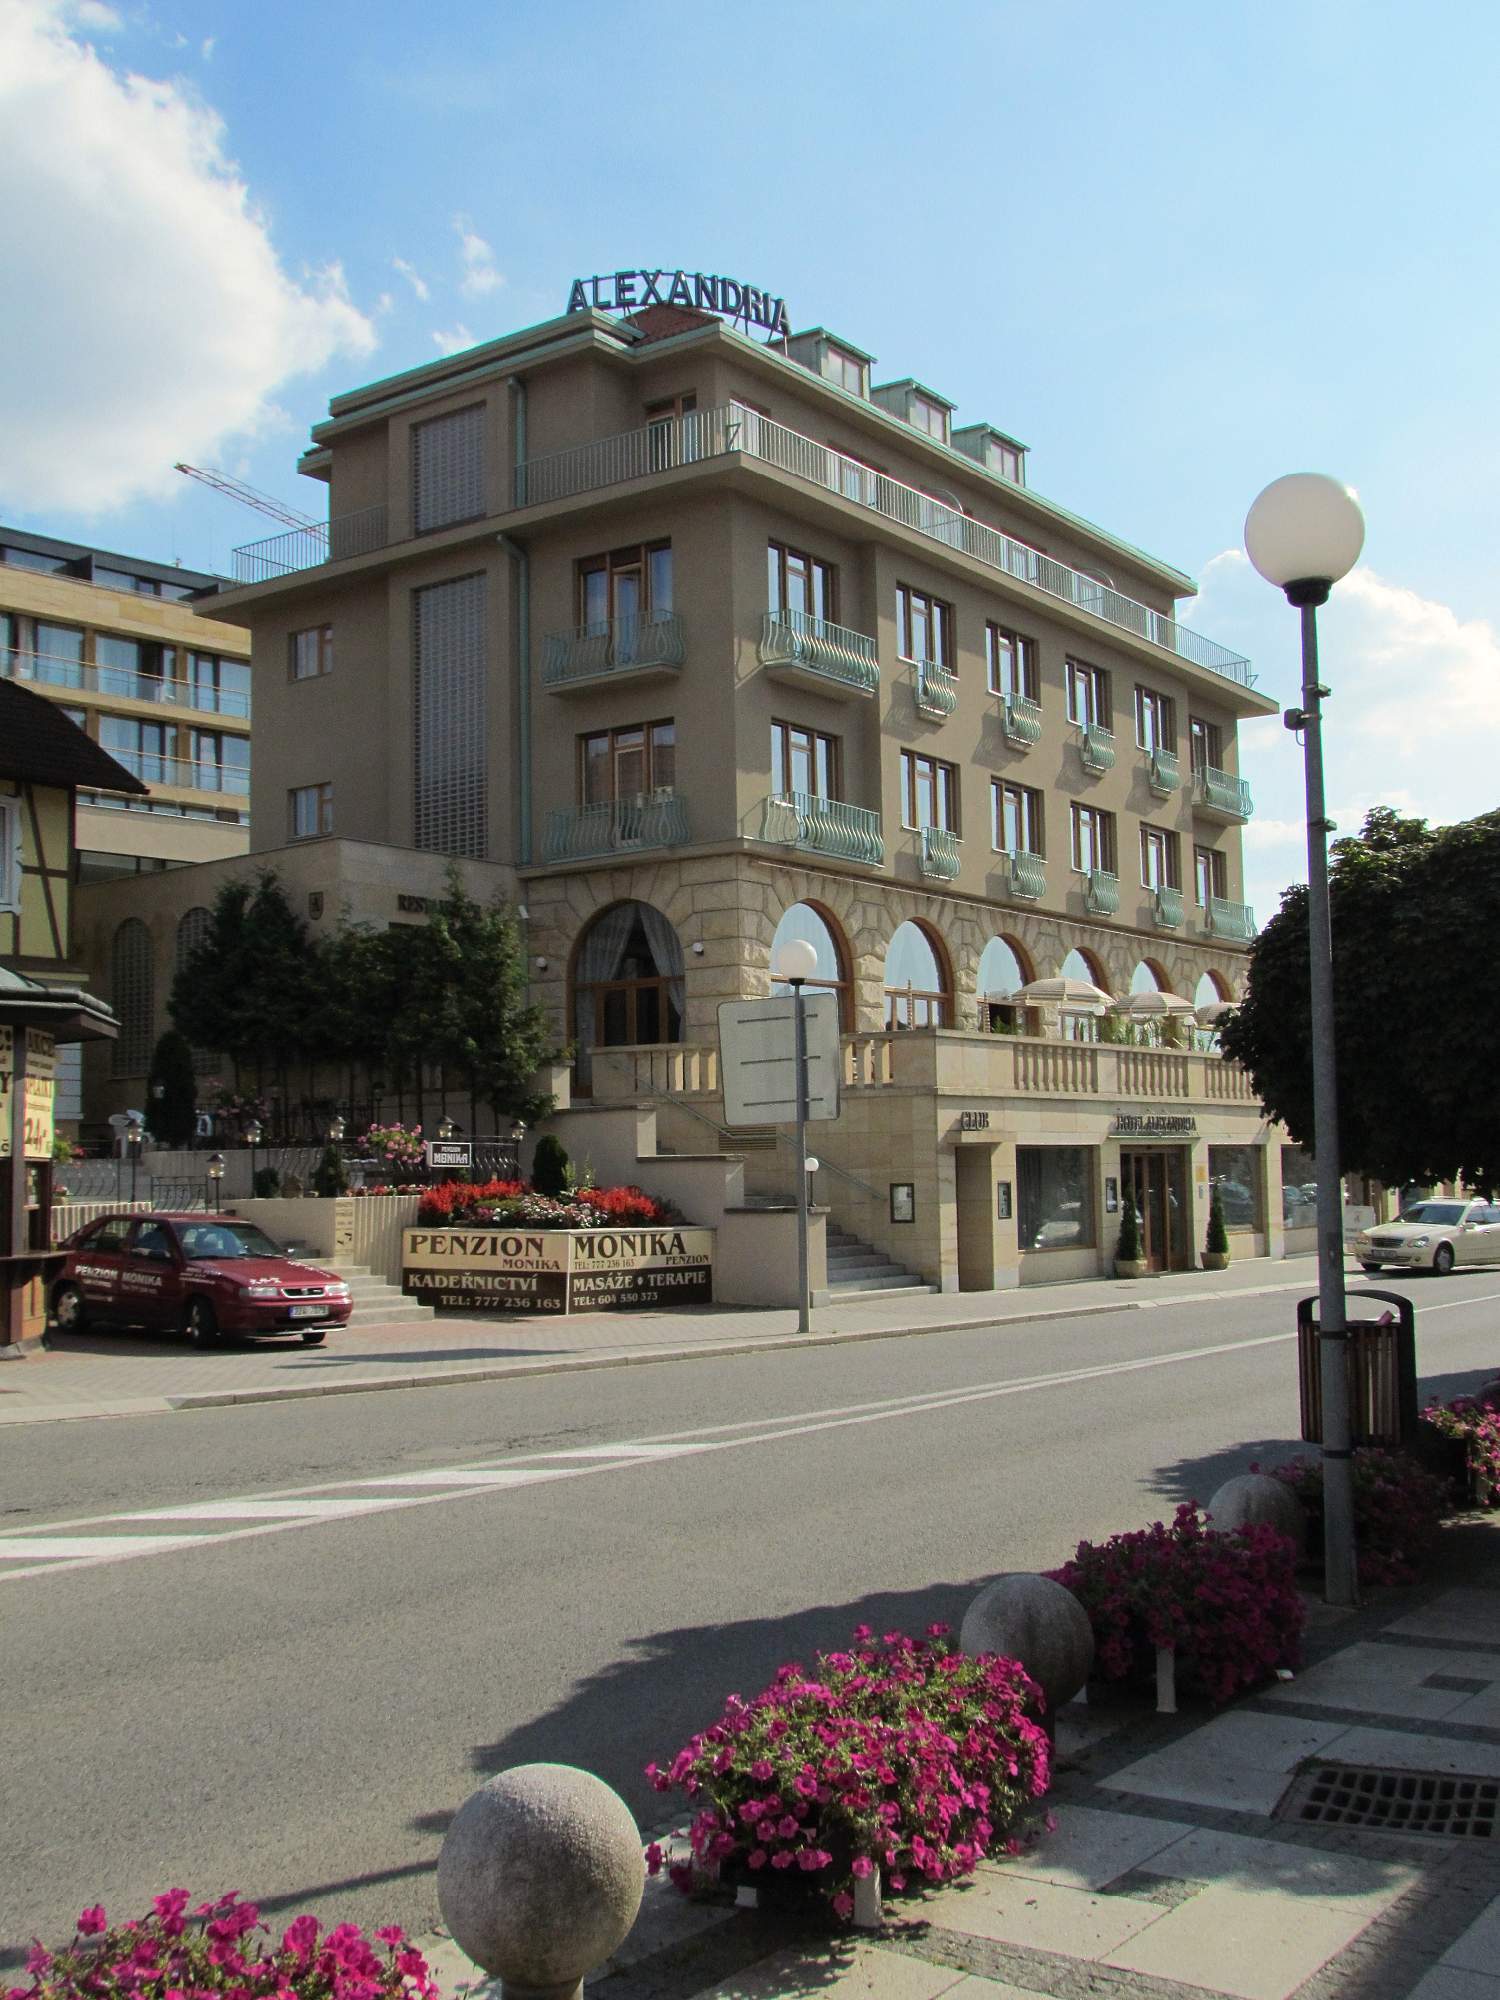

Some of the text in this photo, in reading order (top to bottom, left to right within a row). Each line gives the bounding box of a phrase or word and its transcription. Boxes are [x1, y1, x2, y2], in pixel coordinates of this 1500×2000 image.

[567, 269, 792, 336] ALEXANDRIA
[961, 1111, 989, 1131] CLUB
[1116, 1115, 1143, 1130] HOTEL
[433, 1153, 468, 1164] MONIKA
[410, 1234, 544, 1257] PENZION
[573, 1232, 687, 1259] MONIKA
[502, 1258, 560, 1270] MONIKA
[592, 1260, 605, 1269] 777
[665, 1254, 709, 1265] PENZION
[75, 1264, 119, 1280] PENZION
[122, 1271, 163, 1287] MONIKA
[408, 1272, 538, 1291] KADEŘNICTVÍ
[573, 1271, 706, 1292] MASÁŽE TERAPIE
[441, 1295, 561, 1309] TEL: 777 236 163
[573, 1296, 595, 1306] TEL:
